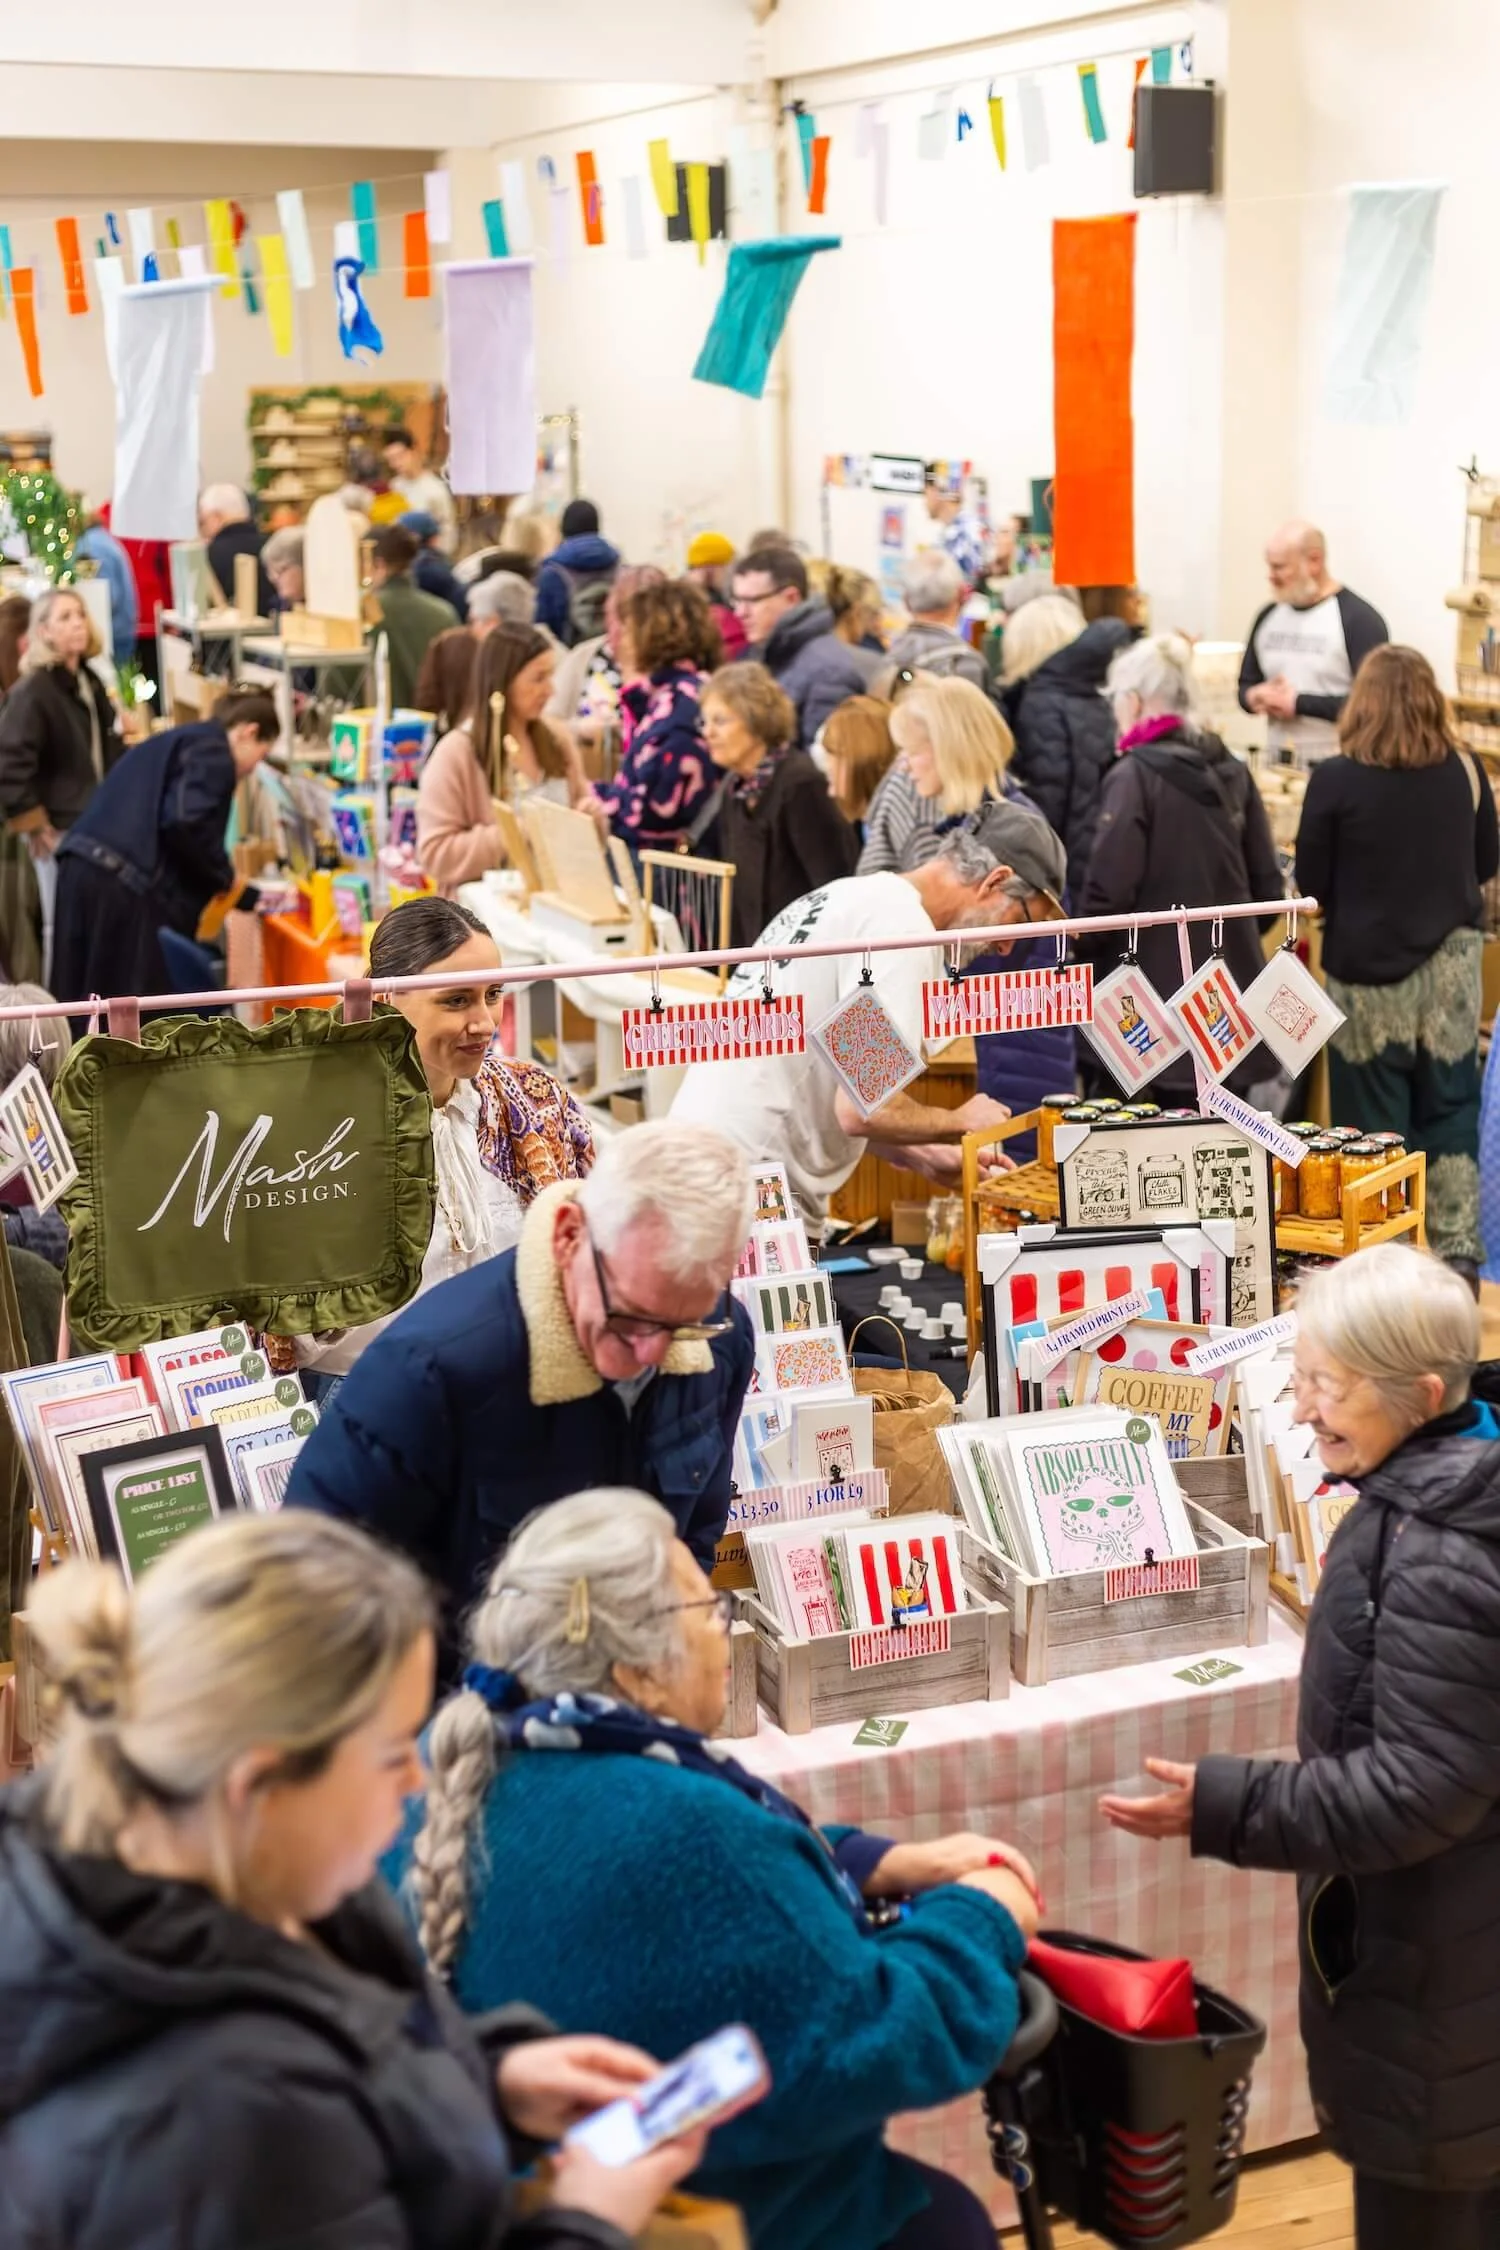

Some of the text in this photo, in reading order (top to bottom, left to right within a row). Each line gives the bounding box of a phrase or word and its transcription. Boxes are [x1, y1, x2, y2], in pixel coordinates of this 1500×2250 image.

[930, 982, 1088, 1024] WALL PRINTS
[625, 1011, 801, 1052] GREETING CARDS
[1218, 1098, 1255, 1129] FRAMED
[1253, 1122, 1280, 1147] PRINT
[136, 1110, 361, 1243] Mash
[1148, 1187, 1177, 1196] FLAKES
[243, 1181, 358, 1209] DESIGN.
[1083, 1206, 1106, 1216] GREEN
[1046, 1300, 1141, 1353] A4 FRAMED PRINT £22
[1207, 1337, 1246, 1360] FRAMED
[1245, 1326, 1274, 1344] PRINT
[1109, 1377, 1203, 1413] COFFEE
[1166, 1412, 1194, 1431] MY
[122, 1470, 198, 1499] PRICE LIST
[807, 1483, 864, 1511] 3 FOR £9
[741, 1500, 779, 1521] £3.50
